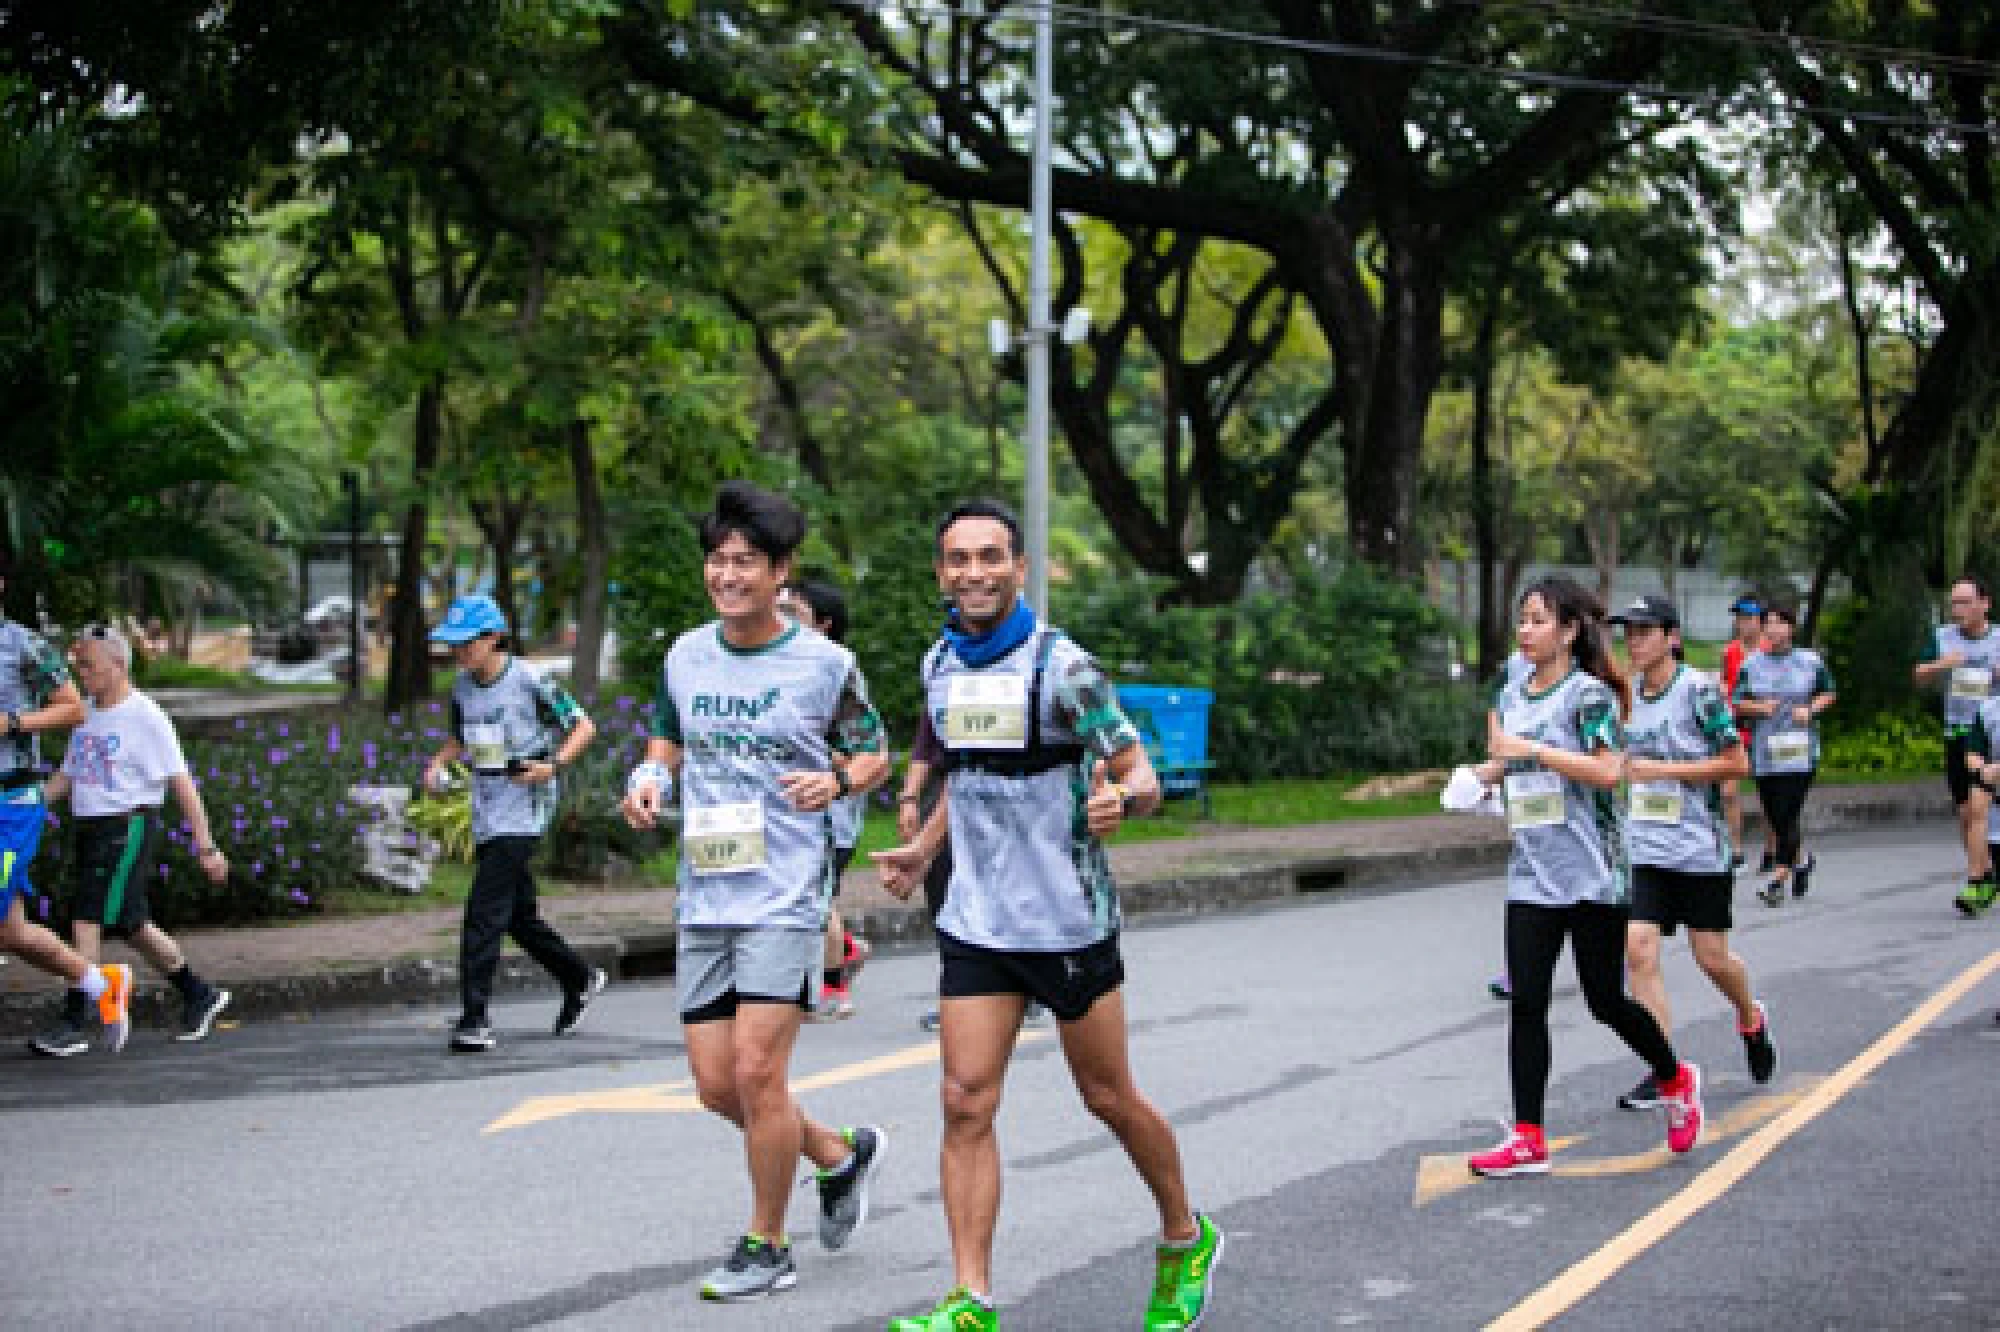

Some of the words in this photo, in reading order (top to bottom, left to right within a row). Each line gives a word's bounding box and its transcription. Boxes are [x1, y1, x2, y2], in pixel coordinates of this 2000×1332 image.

[692, 694, 758, 719] RUN
[963, 712, 997, 732] VIP
[703, 841, 738, 860] VIP
